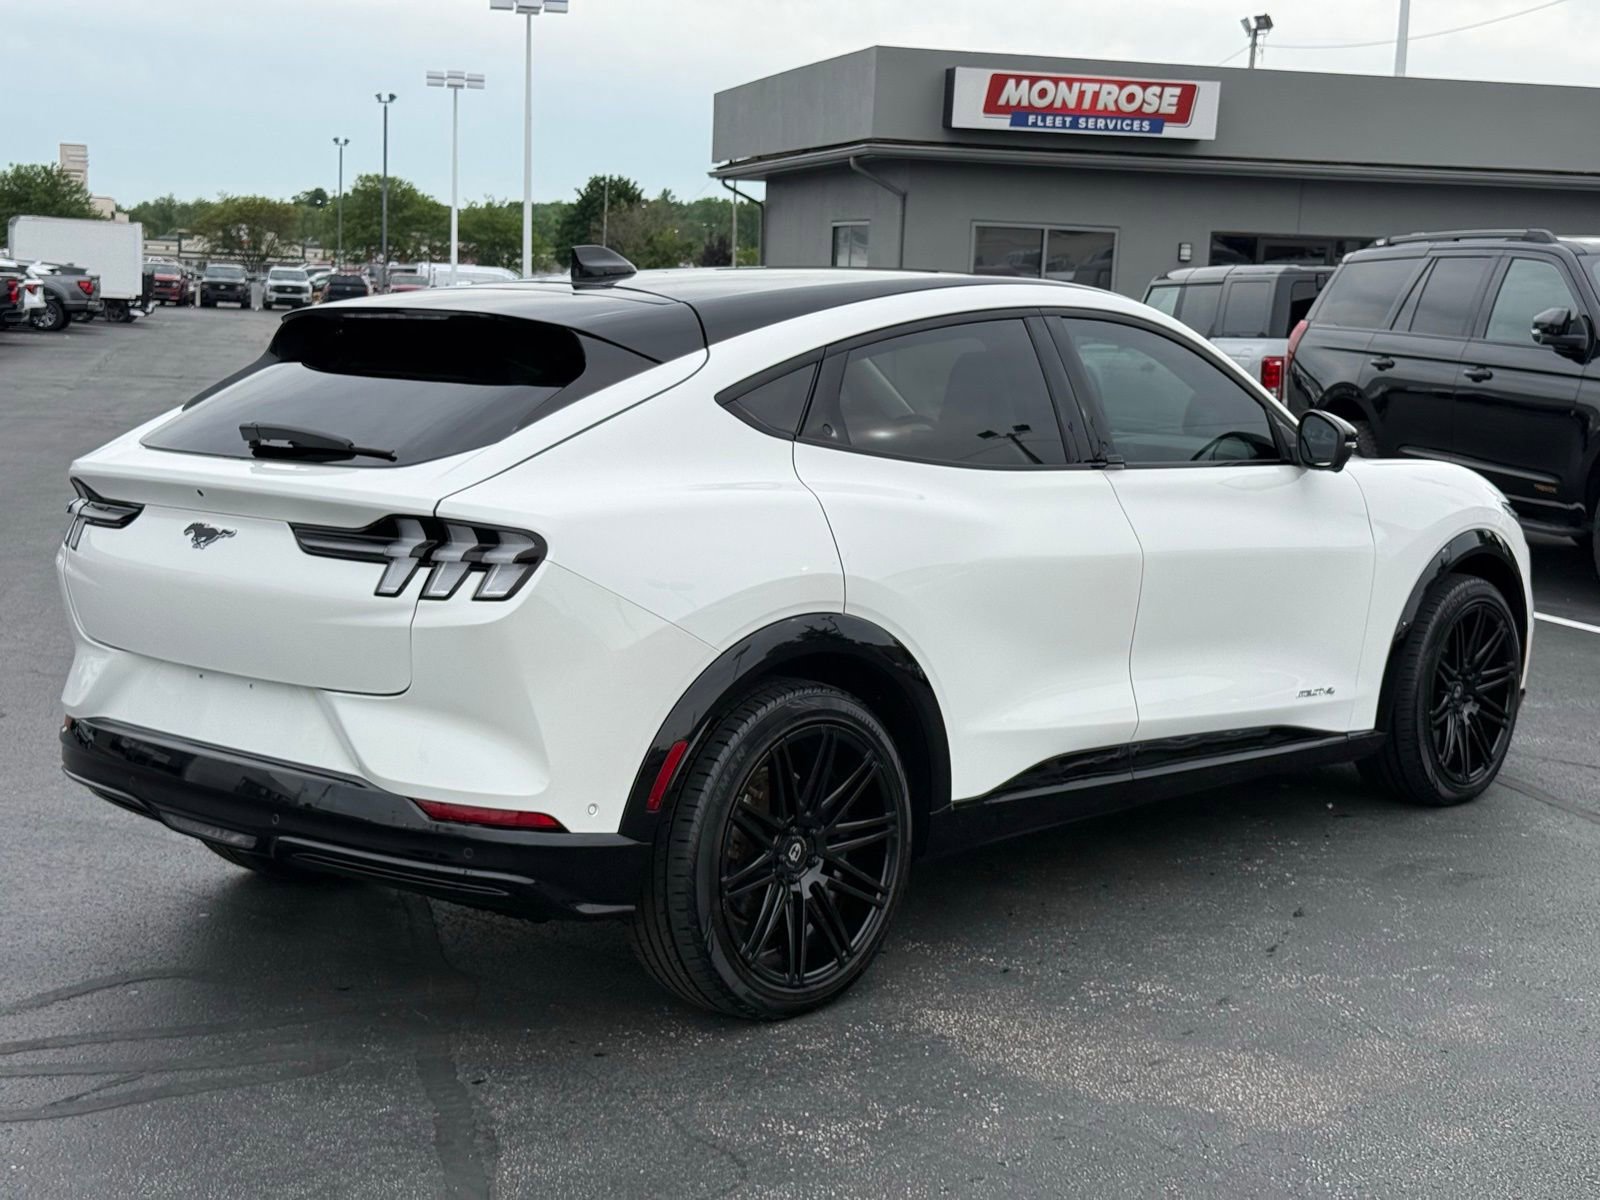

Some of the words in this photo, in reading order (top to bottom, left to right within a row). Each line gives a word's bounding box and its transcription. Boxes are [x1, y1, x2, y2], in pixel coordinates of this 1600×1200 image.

[997, 78, 1182, 114] MONTROSE
[1027, 114, 1072, 128] FLEET
[1078, 118, 1151, 132] SERVICES
